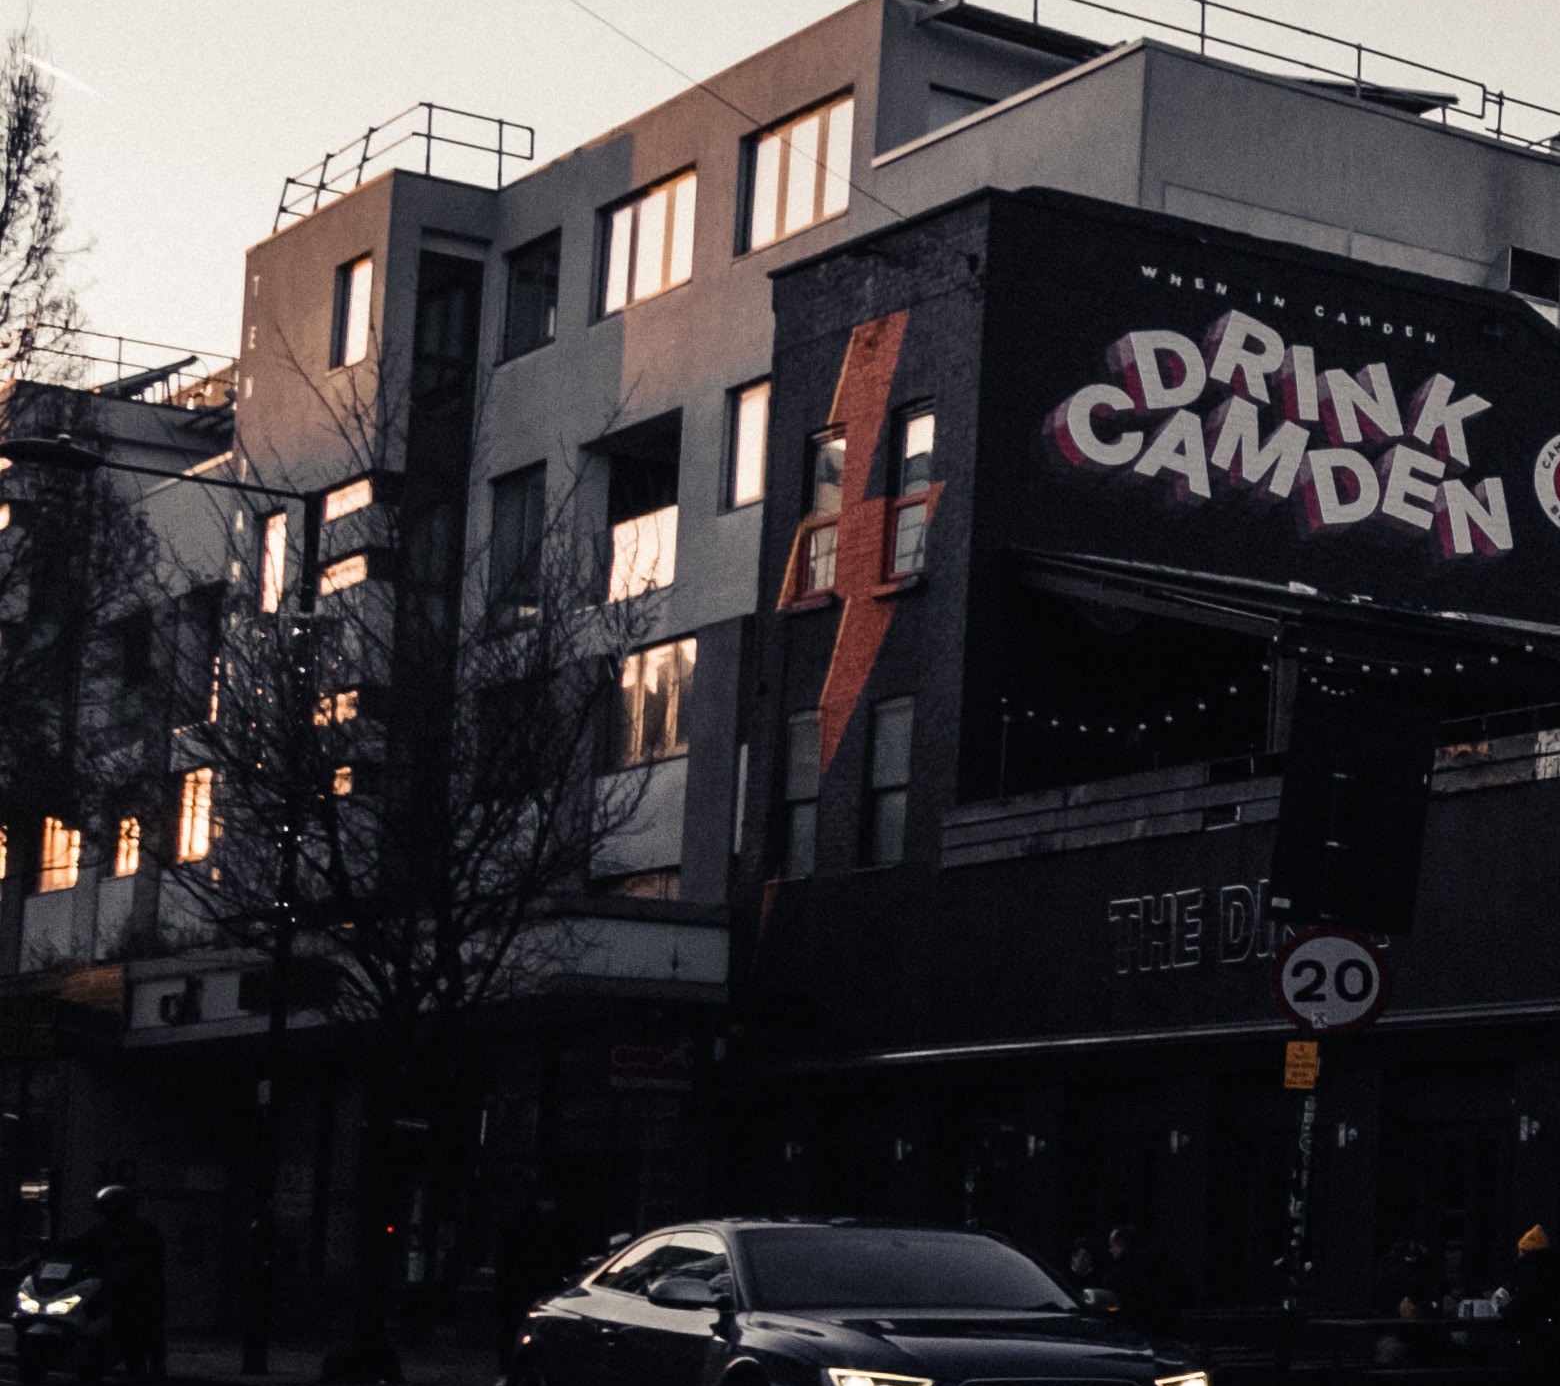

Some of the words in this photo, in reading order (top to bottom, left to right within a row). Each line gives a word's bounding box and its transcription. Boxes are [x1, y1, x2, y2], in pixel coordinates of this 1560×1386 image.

[1141, 265, 1227, 296] WHEN
[1256, 292, 1285, 308] IN
[1314, 305, 1436, 344] CAMDEN
[1110, 309, 1493, 467] DRINK
[1055, 383, 1515, 557] CAMDEN
[1108, 887, 1202, 974] THE
[1291, 959, 1373, 1002] 20
